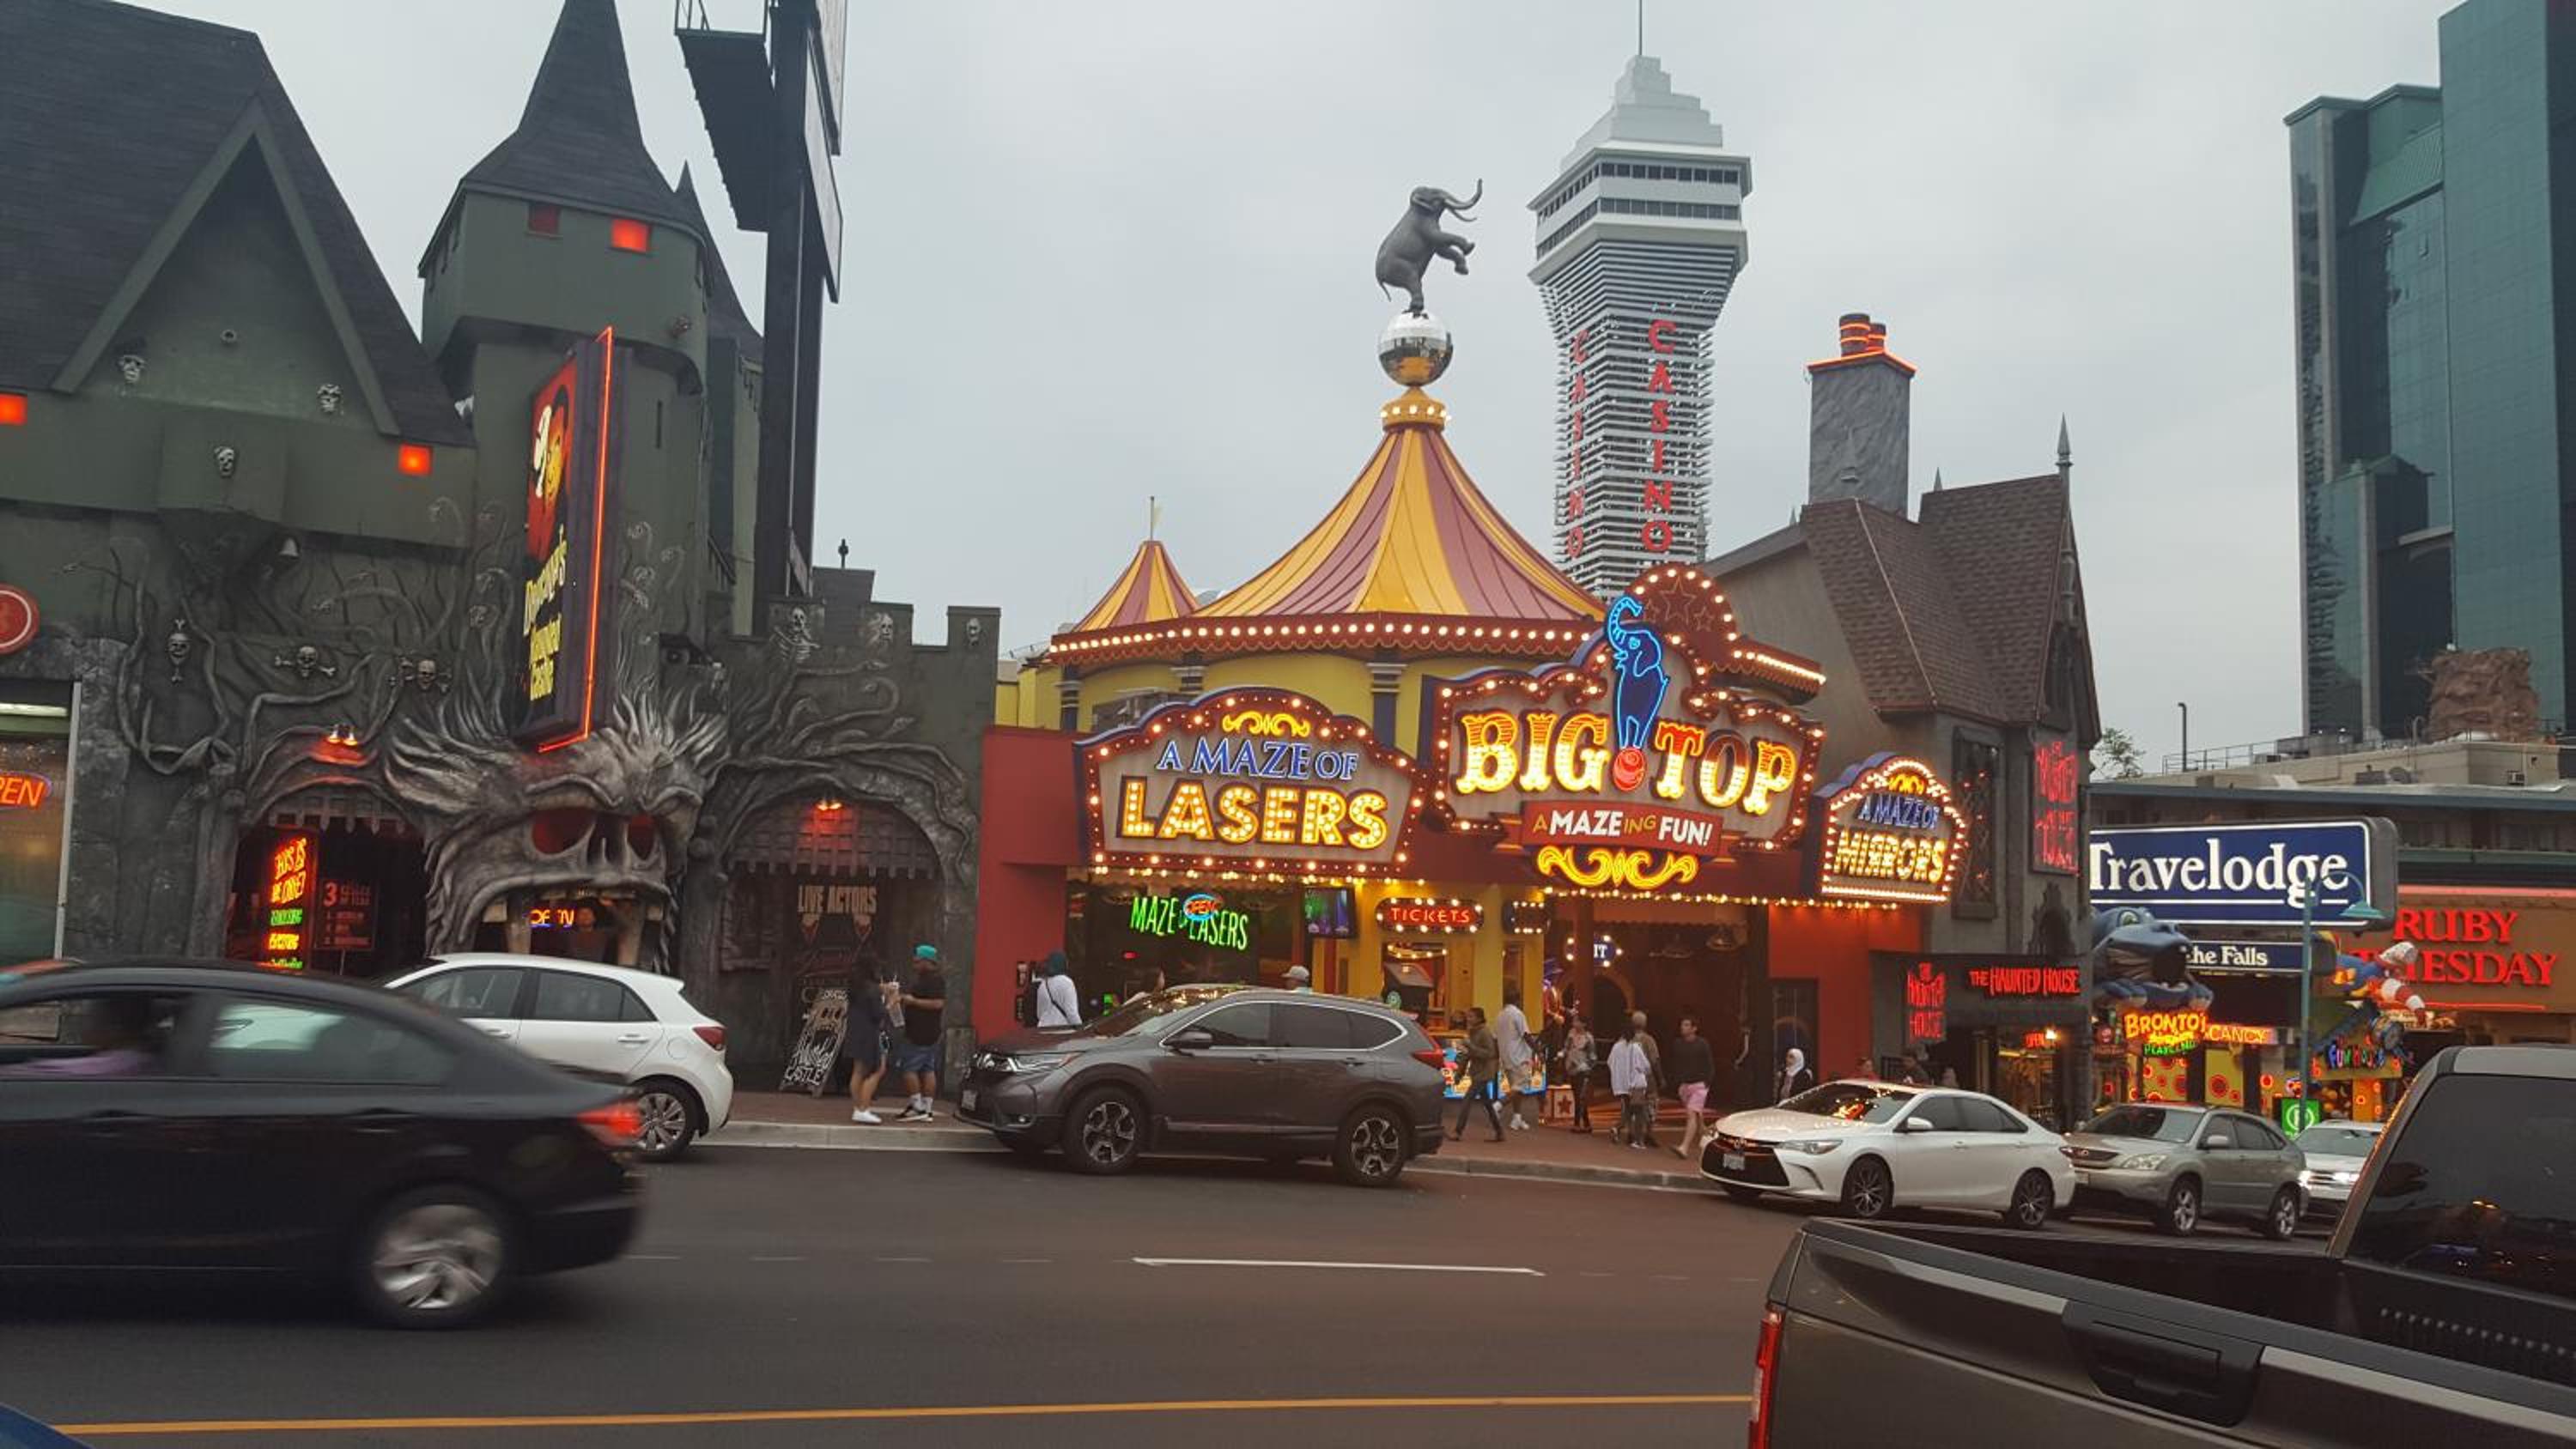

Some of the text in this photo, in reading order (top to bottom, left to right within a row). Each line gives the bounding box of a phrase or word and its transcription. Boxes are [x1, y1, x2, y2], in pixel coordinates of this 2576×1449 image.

[1565, 329, 1589, 558] CASINO
[1641, 319, 1676, 552] CASINO
[1157, 737, 1358, 780] A MAZE OF
[1456, 712, 1797, 814] BIG TOP
[1121, 777, 1388, 849] LASERS
[1658, 816, 1713, 846] FUN!
[1872, 795, 1923, 828] MAZE
[1923, 806, 1940, 830] OF
[1834, 829, 1947, 883] MIRRORS
[2090, 838, 2348, 908] Travelodge
[828, 885, 877, 914] ACTORS
[1130, 895, 1179, 936] MAZE
[1391, 907, 1470, 924] TICKETS
[2393, 907, 2518, 944] RUBY
[2221, 945, 2268, 967] Falls
[1969, 967, 2081, 996] THE HAUNTED HOUSE
[1910, 1010, 1944, 1040] HOUSE
